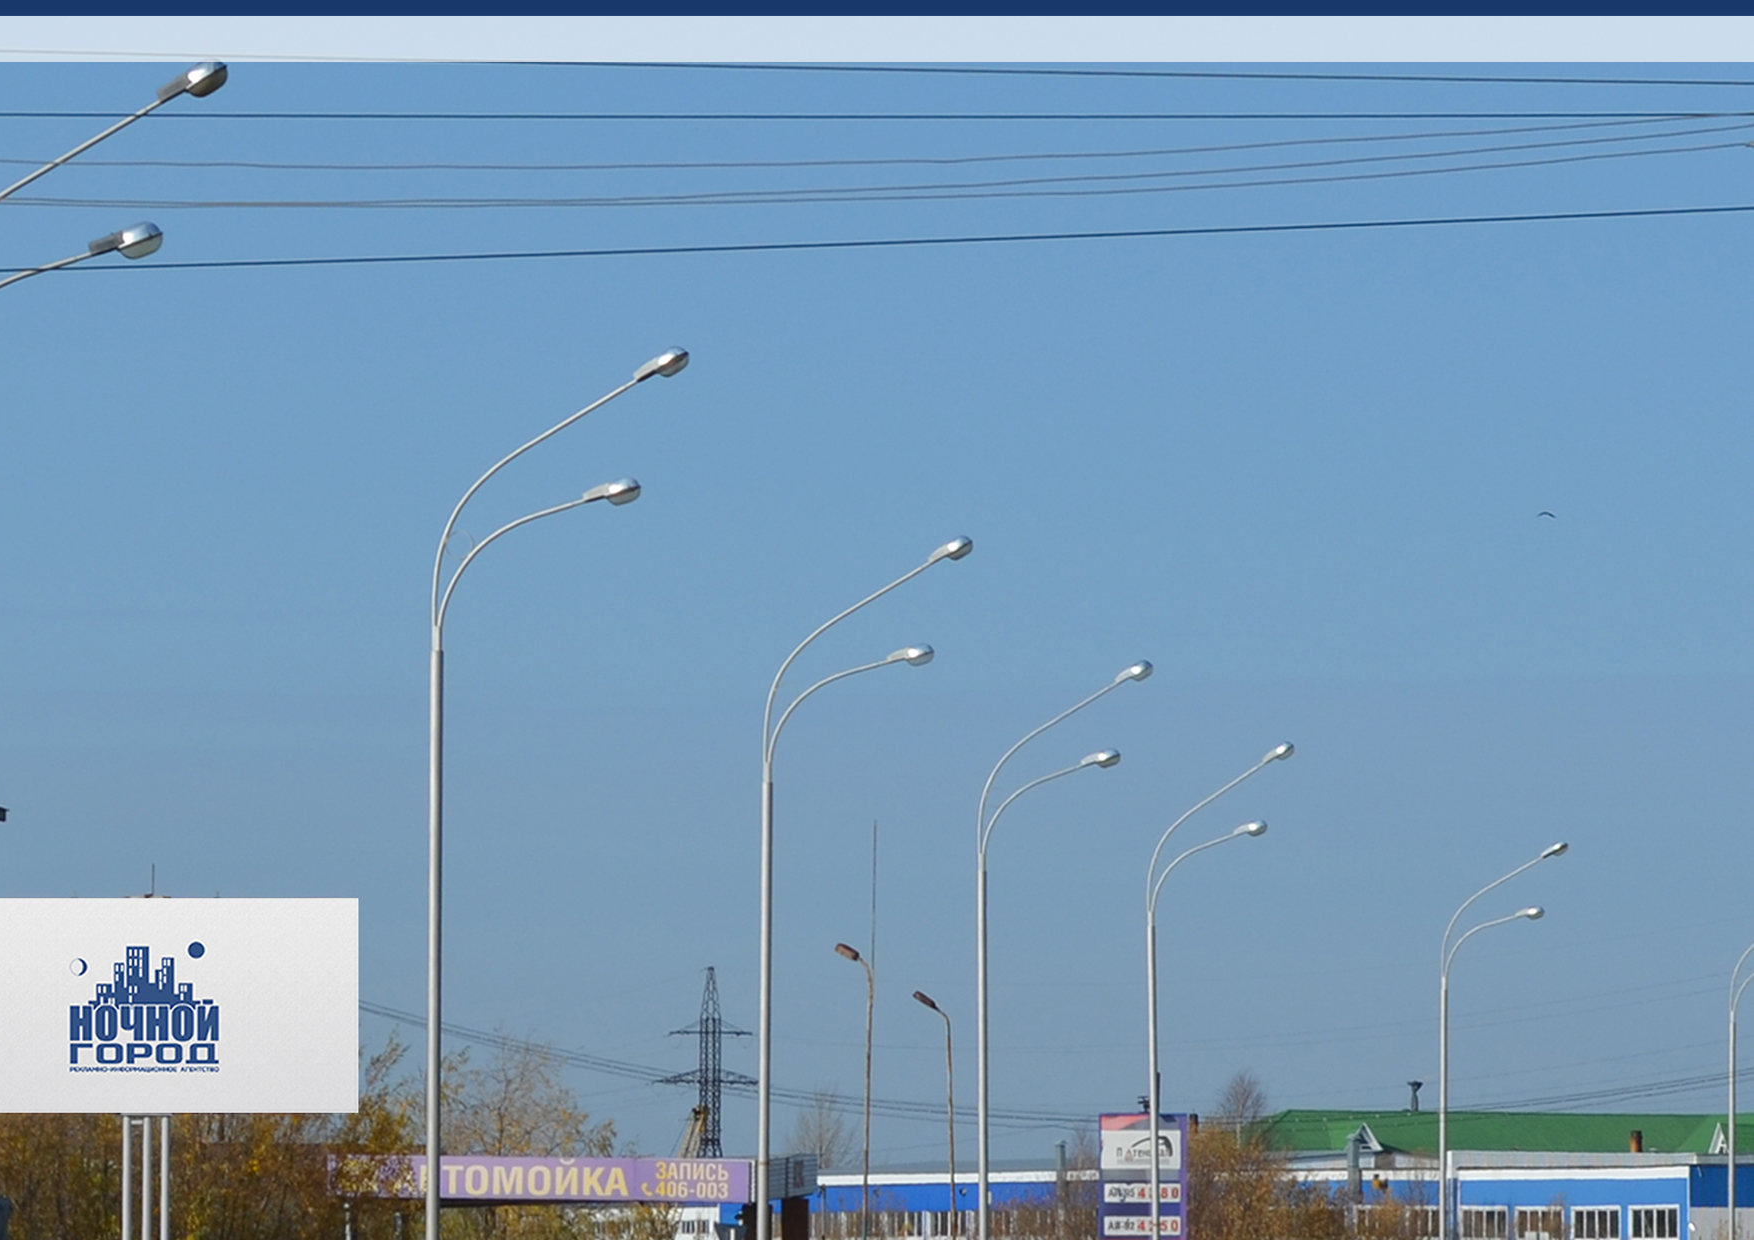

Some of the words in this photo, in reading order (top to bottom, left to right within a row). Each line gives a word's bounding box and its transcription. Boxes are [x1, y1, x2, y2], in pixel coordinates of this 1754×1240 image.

[69, 1001, 220, 1042] НОЧНОЙ
[69, 1043, 220, 1064] ГОРОД
[655, 1161, 729, 1181] ЗАПИСЬ
[655, 1181, 729, 1198] 406-003
